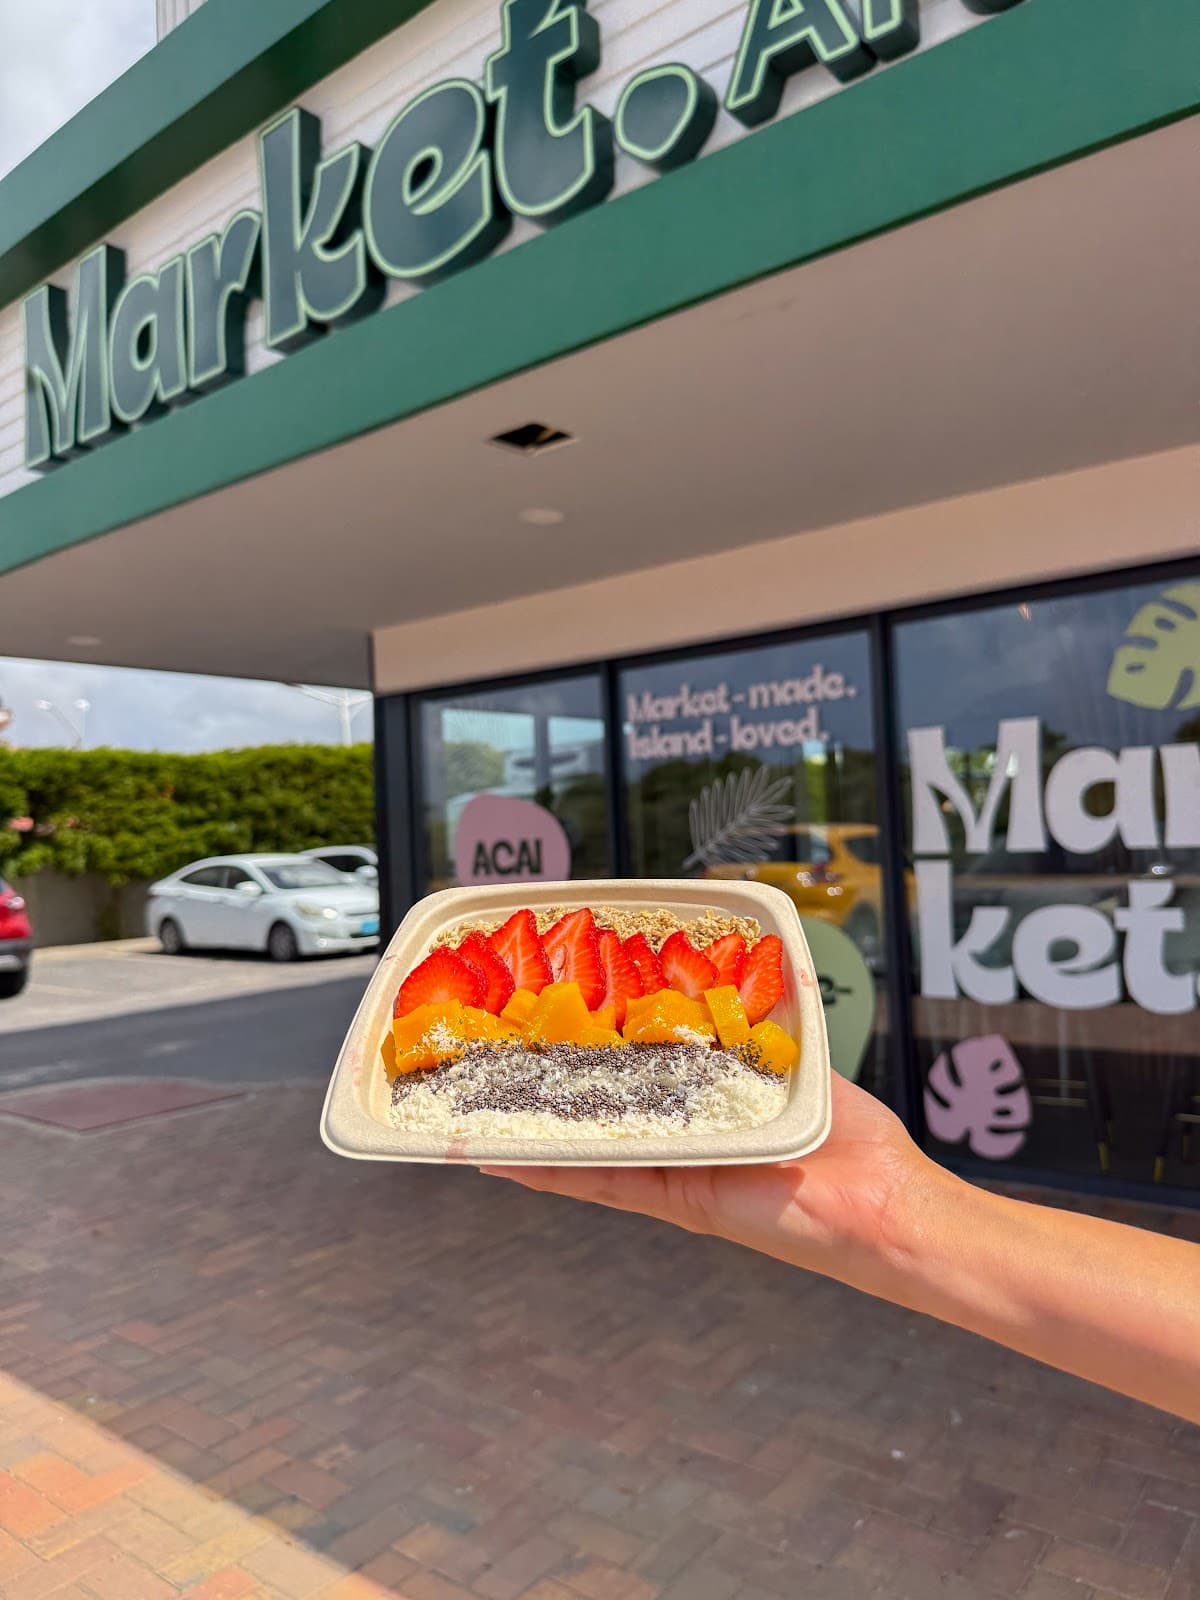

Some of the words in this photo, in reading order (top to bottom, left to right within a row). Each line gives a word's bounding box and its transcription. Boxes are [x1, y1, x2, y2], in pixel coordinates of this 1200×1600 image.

[24, 0, 702, 470] Market.
[472, 838, 543, 877] ACAI
[915, 859, 1200, 1015] ket
